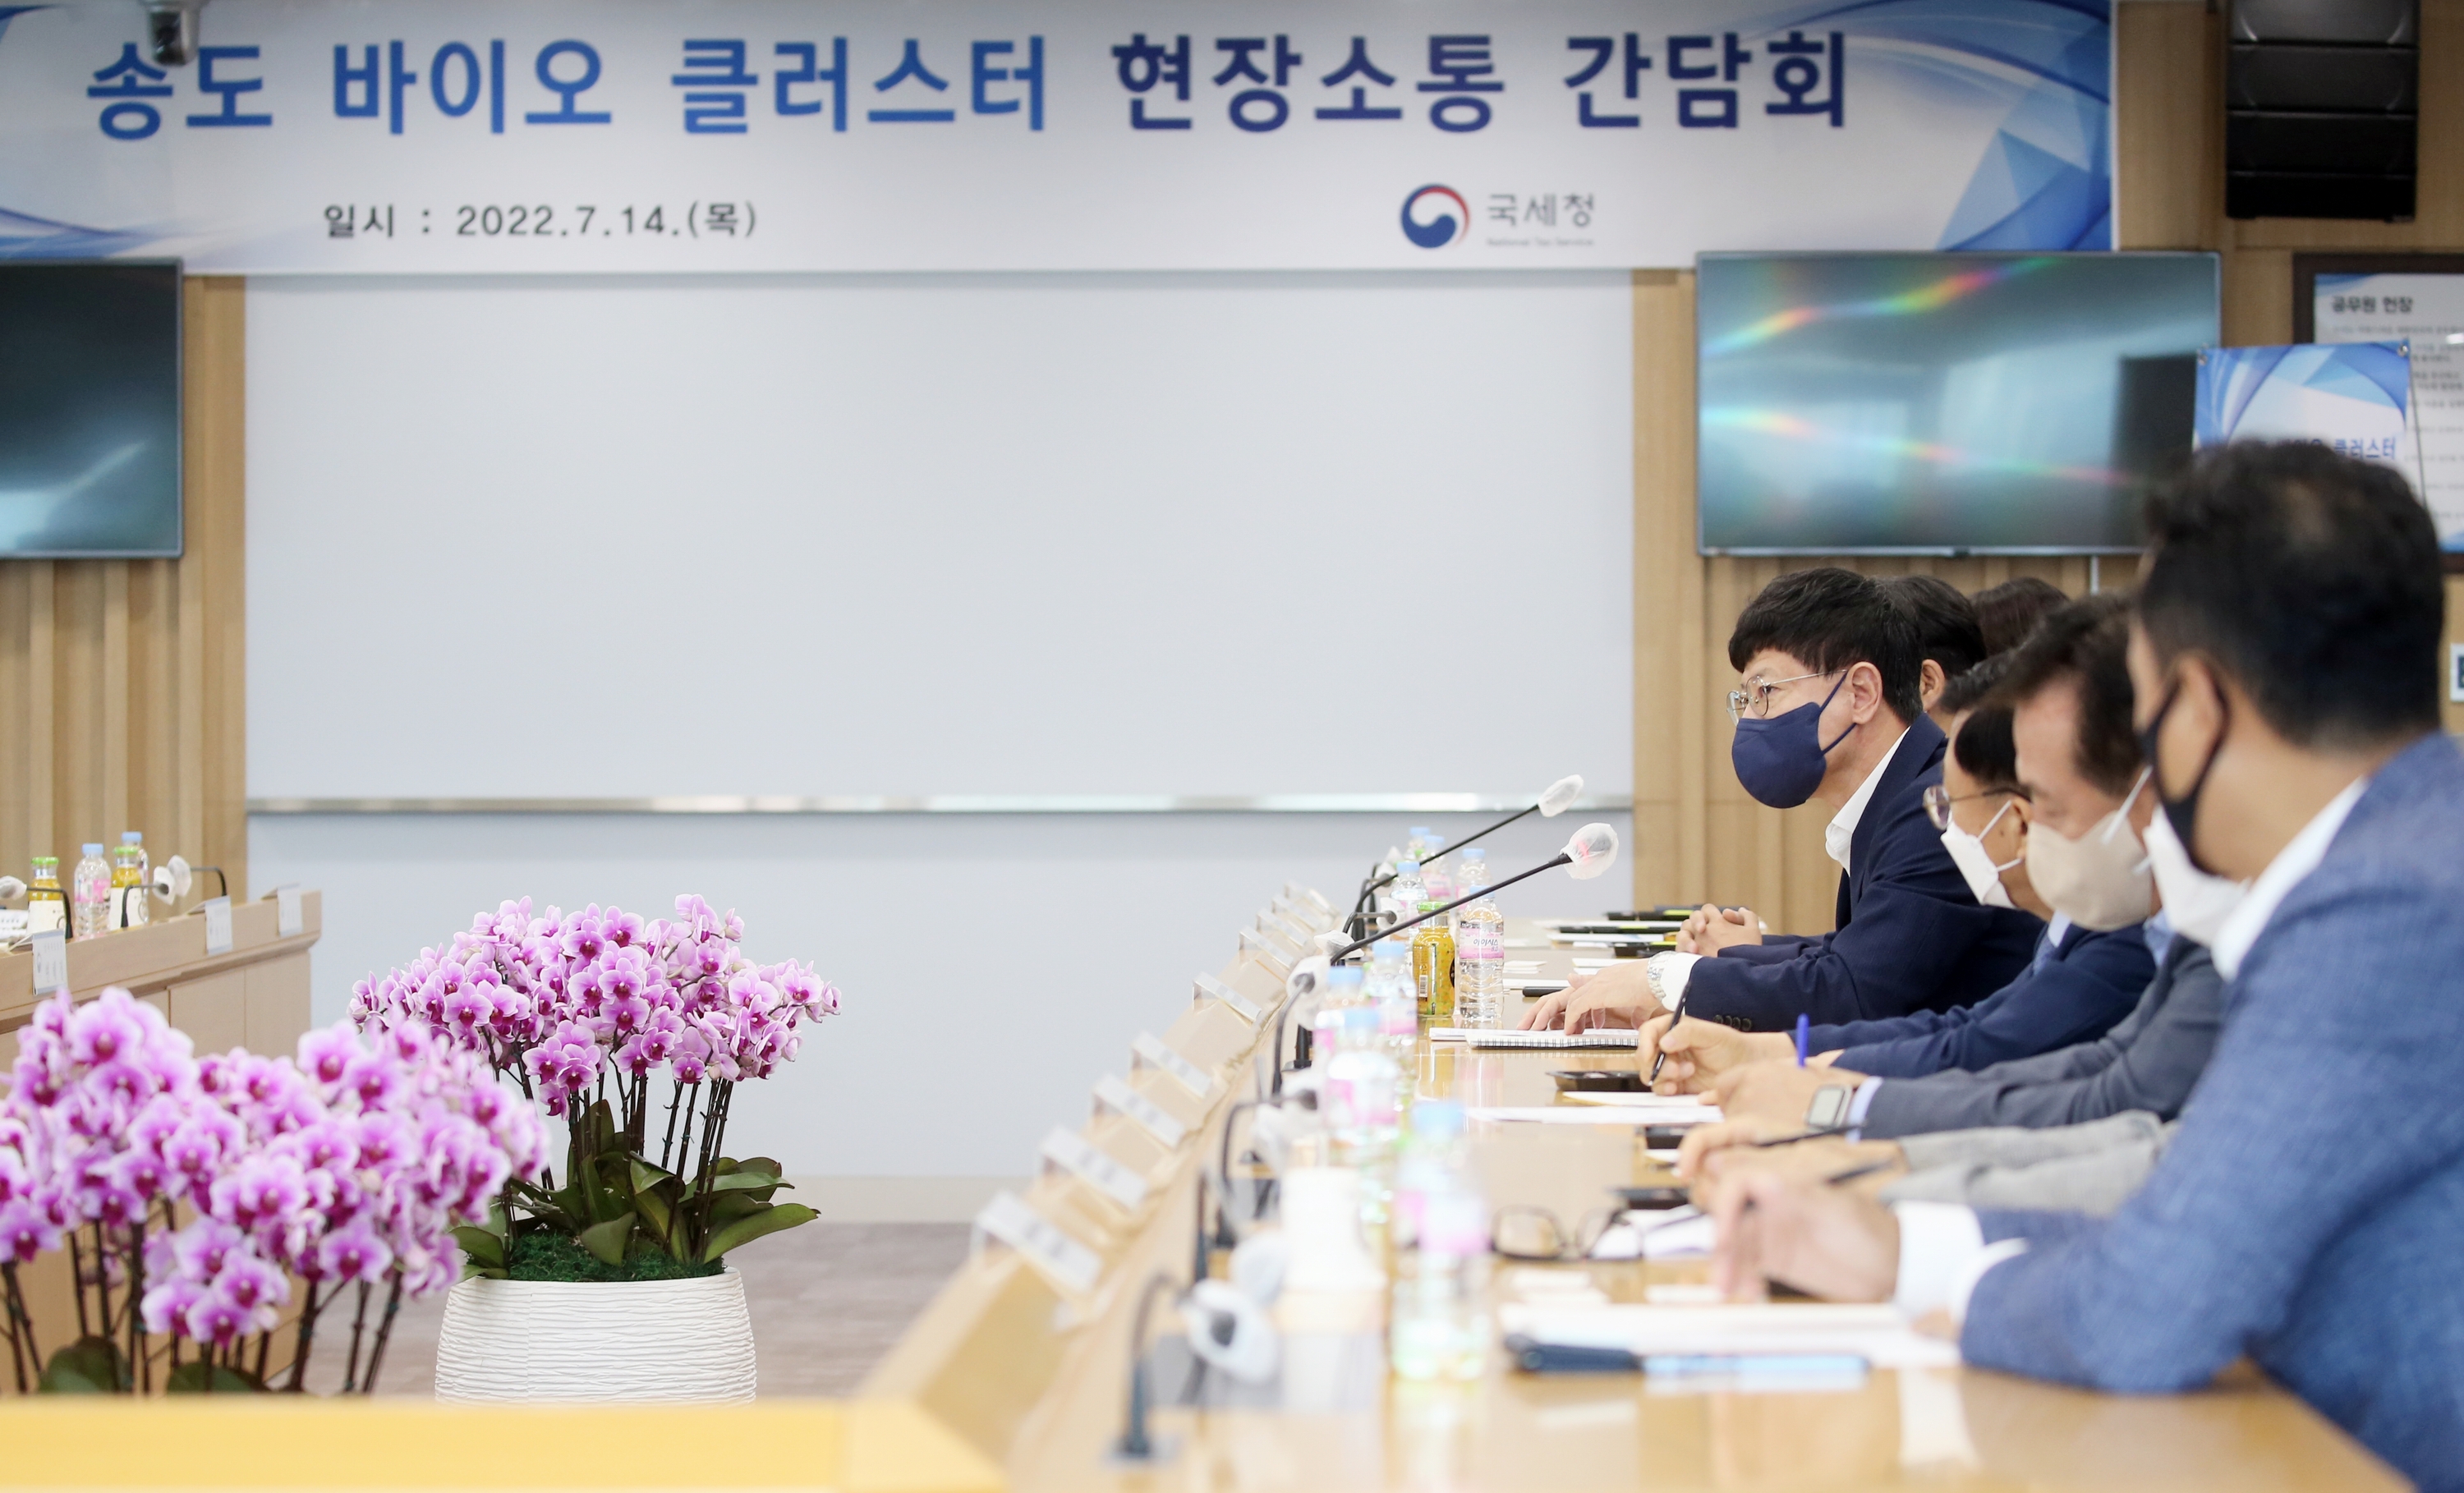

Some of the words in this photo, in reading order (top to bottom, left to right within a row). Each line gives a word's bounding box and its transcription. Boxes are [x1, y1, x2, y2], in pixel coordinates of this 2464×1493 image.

[86, 41, 274, 140] 송도
[332, 38, 612, 136] 바이오
[671, 35, 1045, 133] 클러스터
[1110, 33, 1505, 133] 현장소통
[1563, 30, 1845, 129] 간담회
[324, 204, 393, 239] 일시
[422, 209, 430, 233] :
[457, 201, 756, 238] 2022.7.14.(목)
[1487, 193, 1595, 228] 국세청
[2334, 436, 2396, 460] 클러스터
